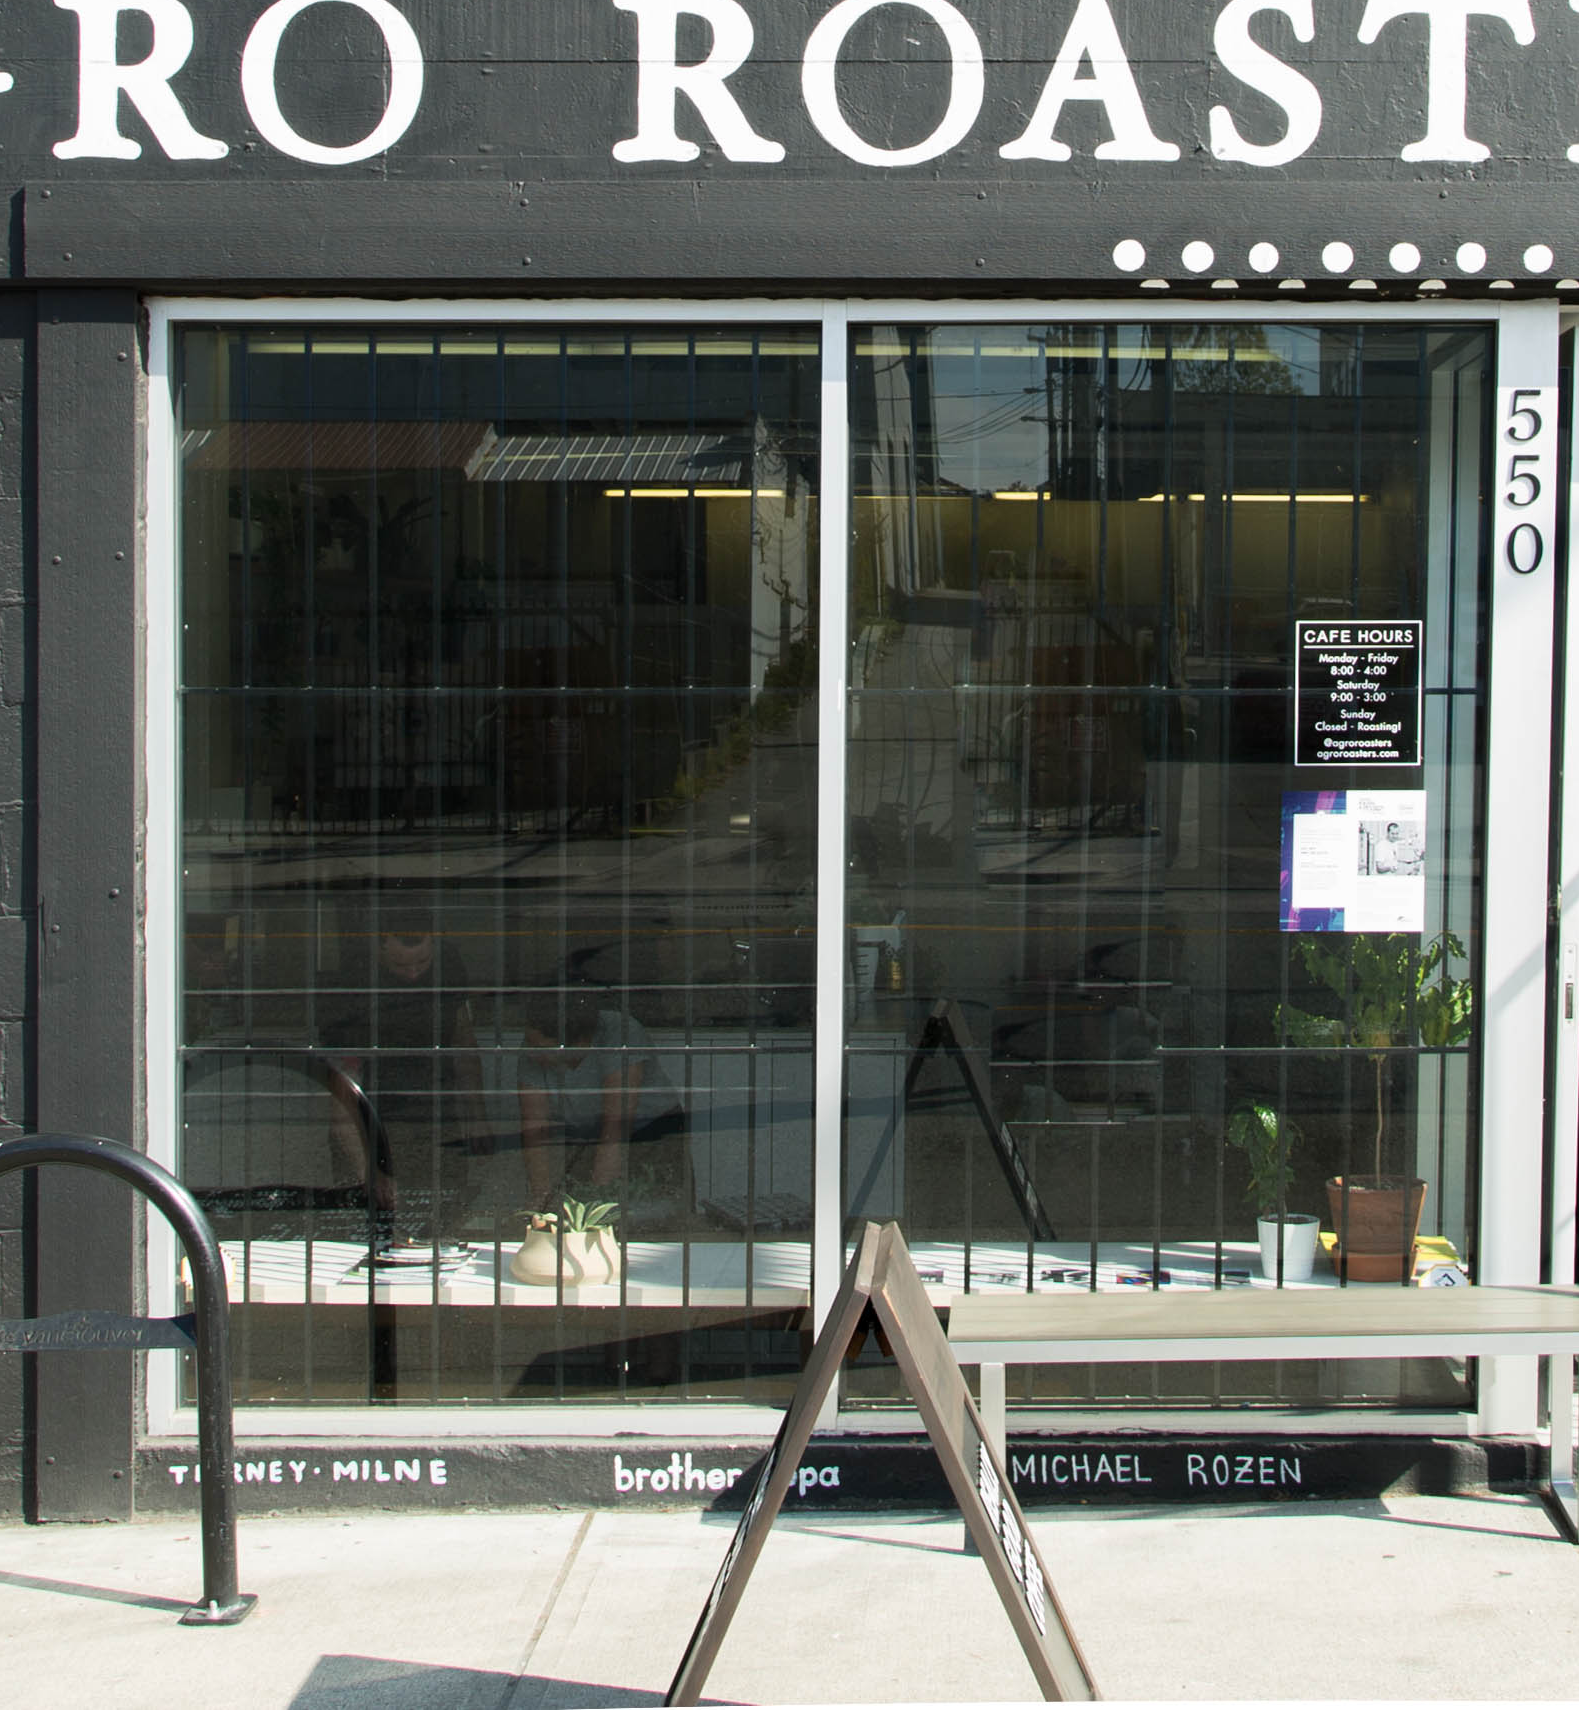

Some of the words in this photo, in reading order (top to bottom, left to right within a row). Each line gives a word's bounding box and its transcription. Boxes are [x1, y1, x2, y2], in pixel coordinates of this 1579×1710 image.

[1507, 389, 1543, 575] 550
[1303, 629, 1352, 644] CAFE
[1357, 629, 1414, 644] HOURS
[1318, 651, 1359, 666] Monday
[1367, 651, 1400, 665] Friday
[1330, 665, 1355, 676] 8:00
[1363, 665, 1388, 676] 4:00
[1336, 678, 1380, 692] Saturday
[1329, 691, 1354, 703] 9:00
[1363, 691, 1387, 702] 3:00
[1340, 708, 1377, 721] Sunday
[1314, 721, 1348, 732] Closed
[1323, 737, 1393, 751] @agroroasters
[1316, 749, 1400, 761] agroroasters.com
[169, 1460, 307, 1485] TIRNEY
[333, 1458, 447, 1485] MILNE
[614, 1452, 743, 1492] brother
[787, 1465, 840, 1496] pa
[1012, 1454, 1152, 1484] MICHAEL
[1187, 1455, 1302, 1485] ROZEN
